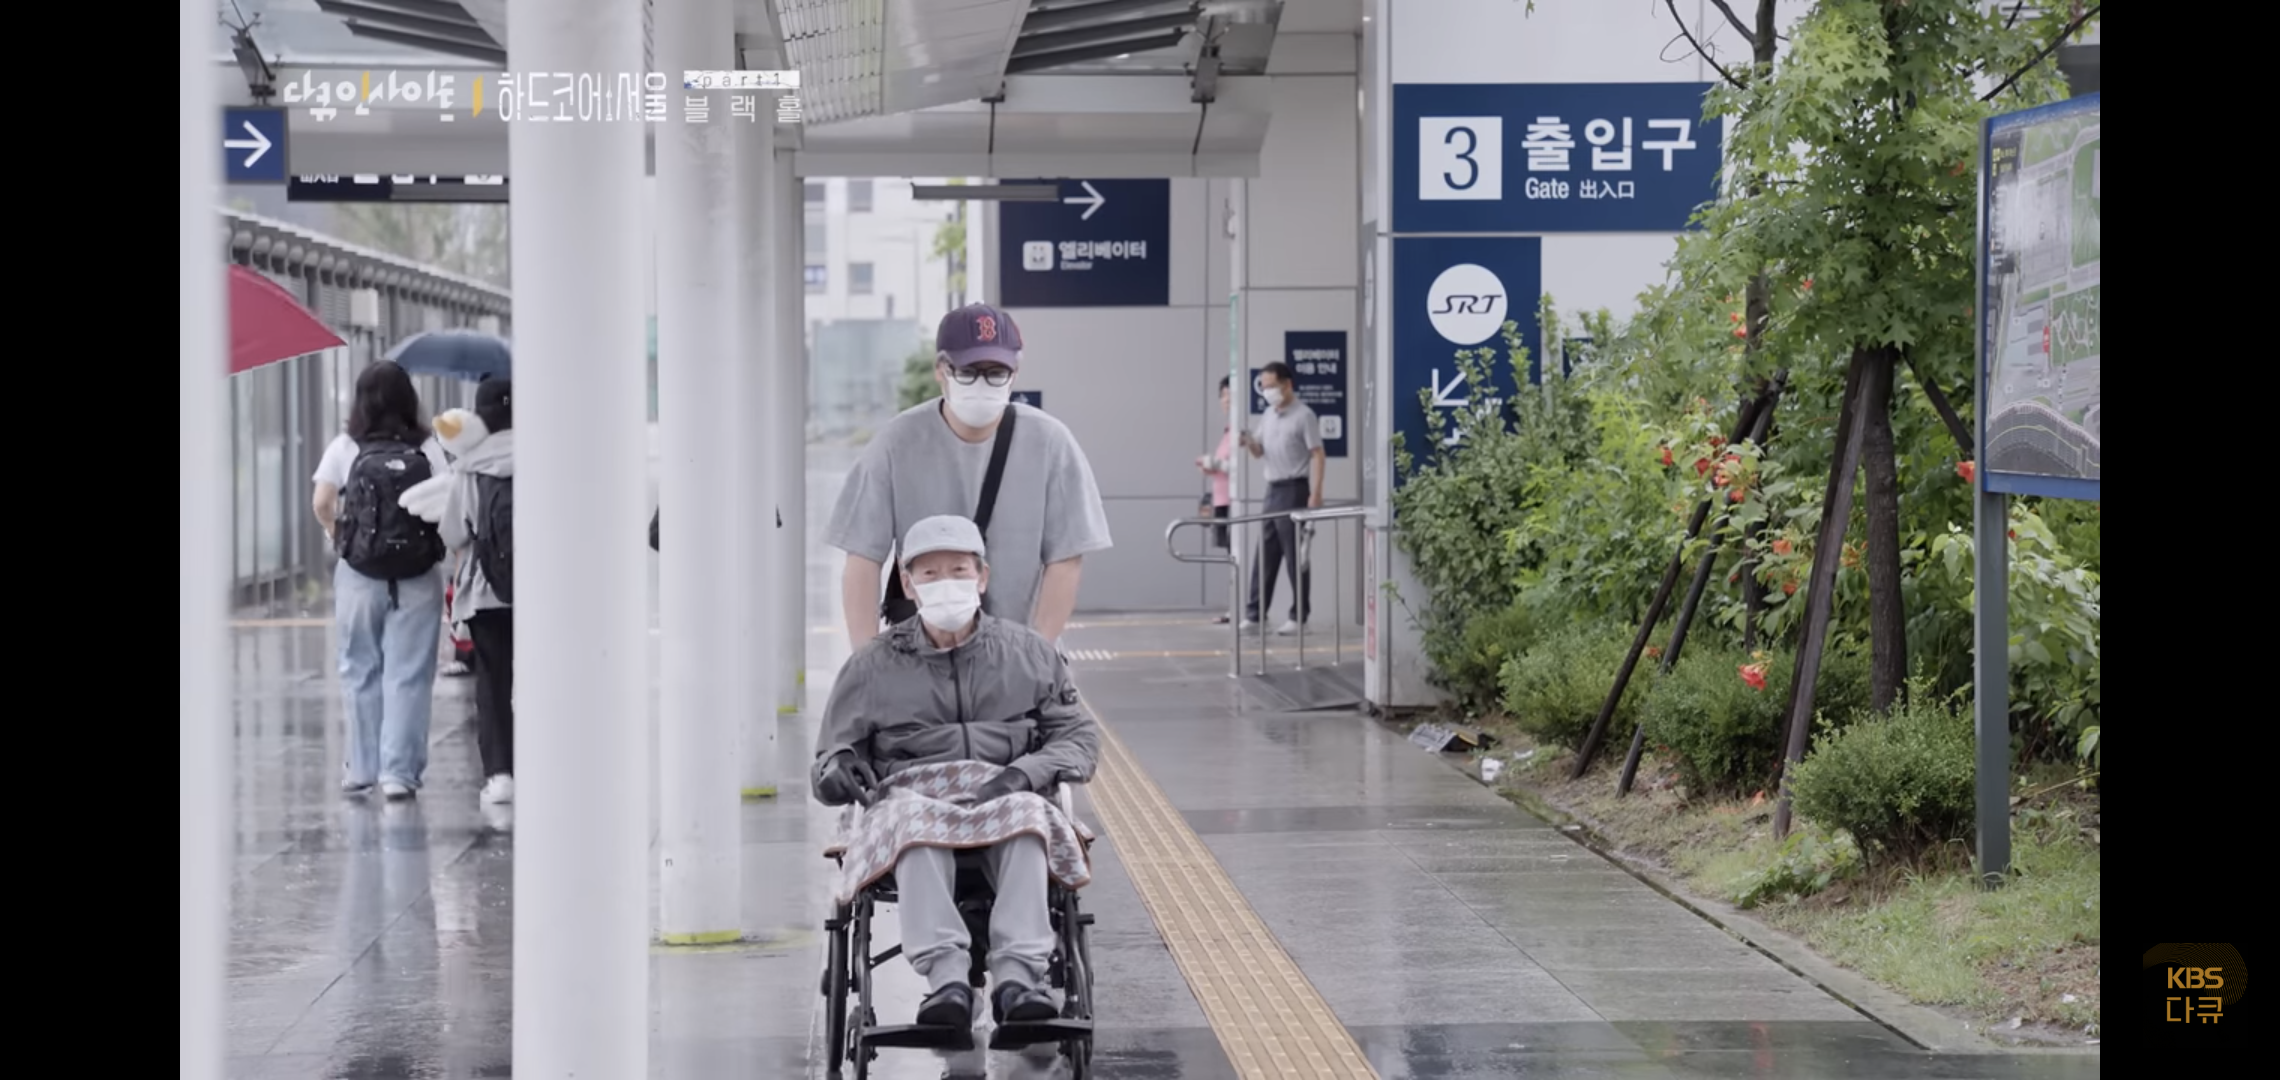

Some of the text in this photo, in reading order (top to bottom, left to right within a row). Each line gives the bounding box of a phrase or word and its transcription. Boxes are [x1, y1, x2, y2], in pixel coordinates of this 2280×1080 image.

[1443, 116, 1697, 190] 3 출입구
[1525, 177, 1635, 199] Gate 出入口
[1058, 240, 1147, 260] 엘리베이터
[1432, 294, 1503, 314] SRT
[976, 315, 997, 341] B
